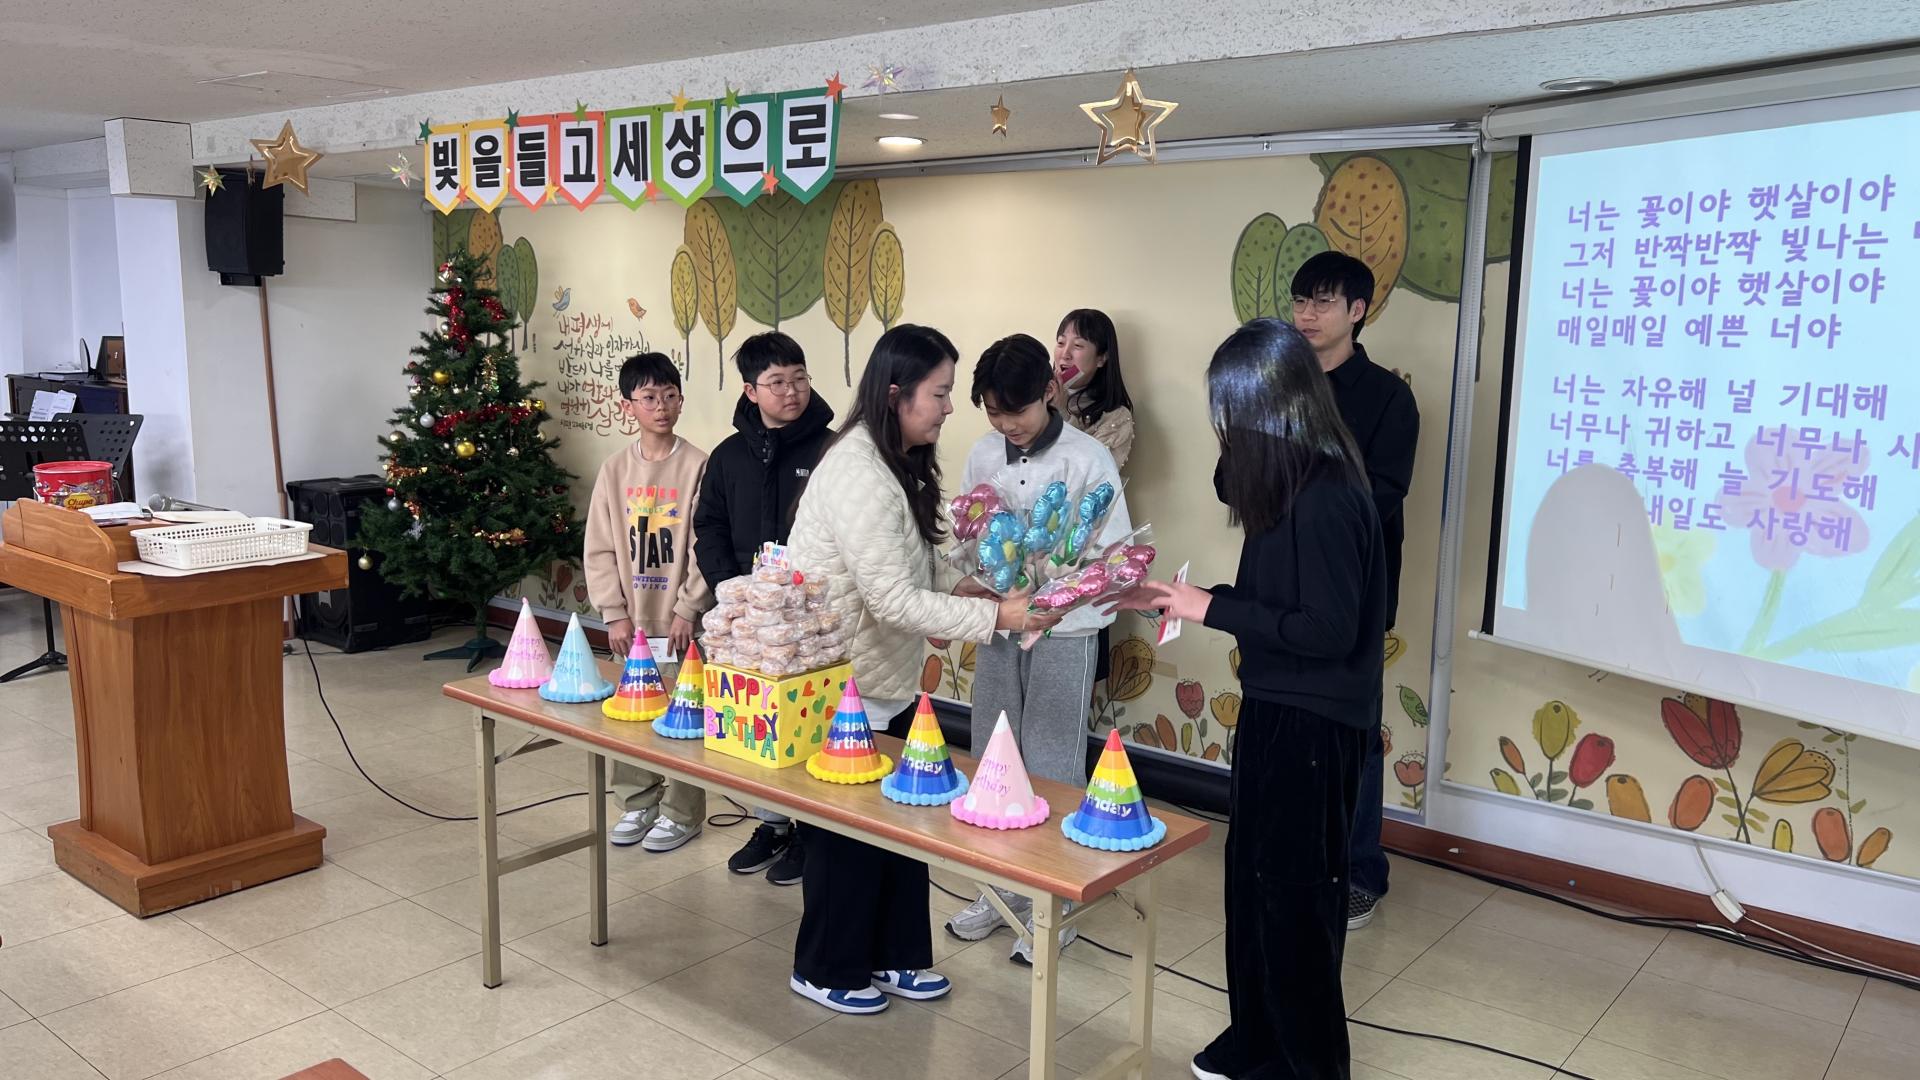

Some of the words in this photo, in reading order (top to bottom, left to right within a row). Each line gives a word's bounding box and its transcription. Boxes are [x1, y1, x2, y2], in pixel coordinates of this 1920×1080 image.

[1568, 200, 1620, 232] 너는
[1637, 188, 1732, 229] 꽃이야
[1747, 174, 1896, 221] 햇살이야
[1563, 237, 1615, 269] 그저
[1634, 228, 1762, 268] 반짝반짝
[1781, 222, 1889, 263] 빛나는
[1561, 277, 1614, 309] 너는
[1629, 272, 1721, 308] 꽃이야
[1737, 267, 1886, 307] 햇살이야
[1557, 314, 1667, 347] 매일매일
[1684, 313, 1749, 348] 예쁜
[1770, 313, 1842, 350] 너야
[1553, 373, 1606, 406] 너는
[1621, 375, 1707, 410] 자유해
[1727, 379, 1756, 414] 널
[1779, 381, 1888, 421] 기대해
[1550, 410, 1631, 445] 너무나
[1645, 416, 1735, 451] 귀하고
[1756, 423, 1868, 465] 너무나
[1615, 452, 1698, 490] 축복해
[1718, 461, 1749, 497] 늘
[1767, 467, 1878, 511] 기도해
[629, 515, 675, 574] STAR
[1746, 507, 1853, 552] 사랑해
[705, 670, 775, 710] HAPPY
[704, 705, 779, 761] BIRTHDAY
